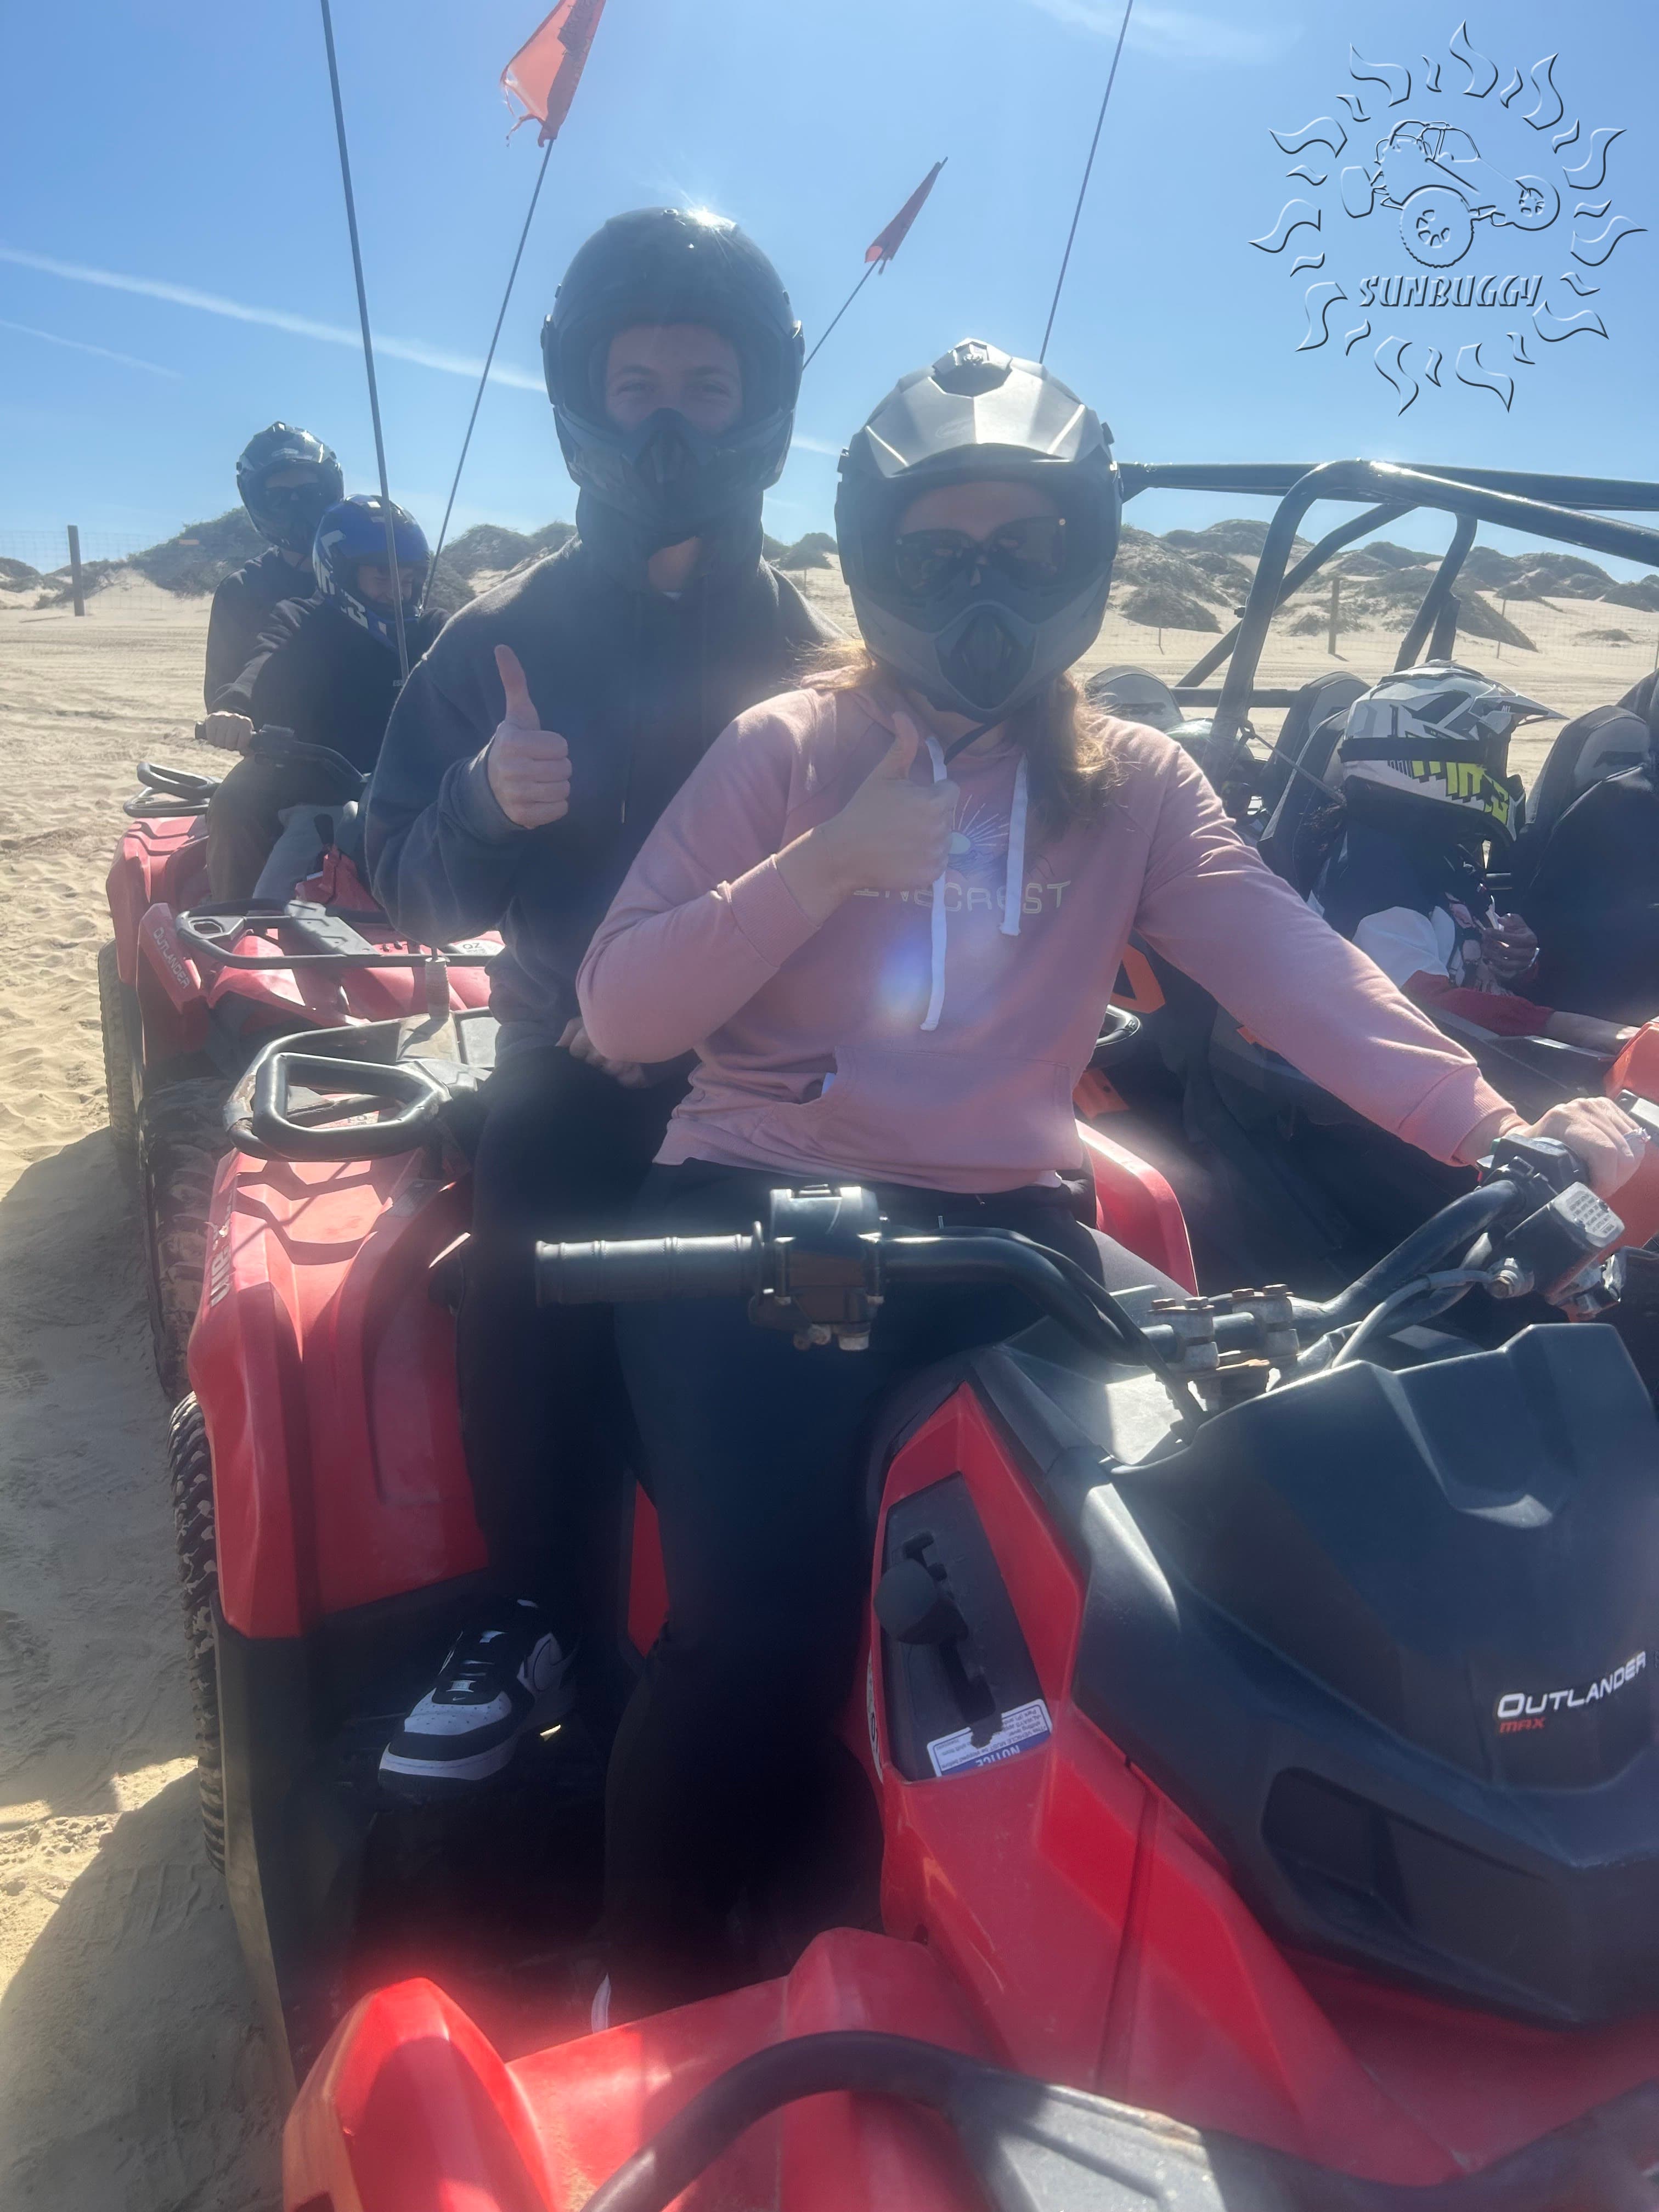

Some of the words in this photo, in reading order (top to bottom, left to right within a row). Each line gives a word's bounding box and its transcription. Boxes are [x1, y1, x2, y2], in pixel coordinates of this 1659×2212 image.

[153, 926, 190, 989] OUTLANDER
[1497, 1651, 1646, 1718] OUTLANDER
[975, 1745, 1020, 1768] NOTICE
